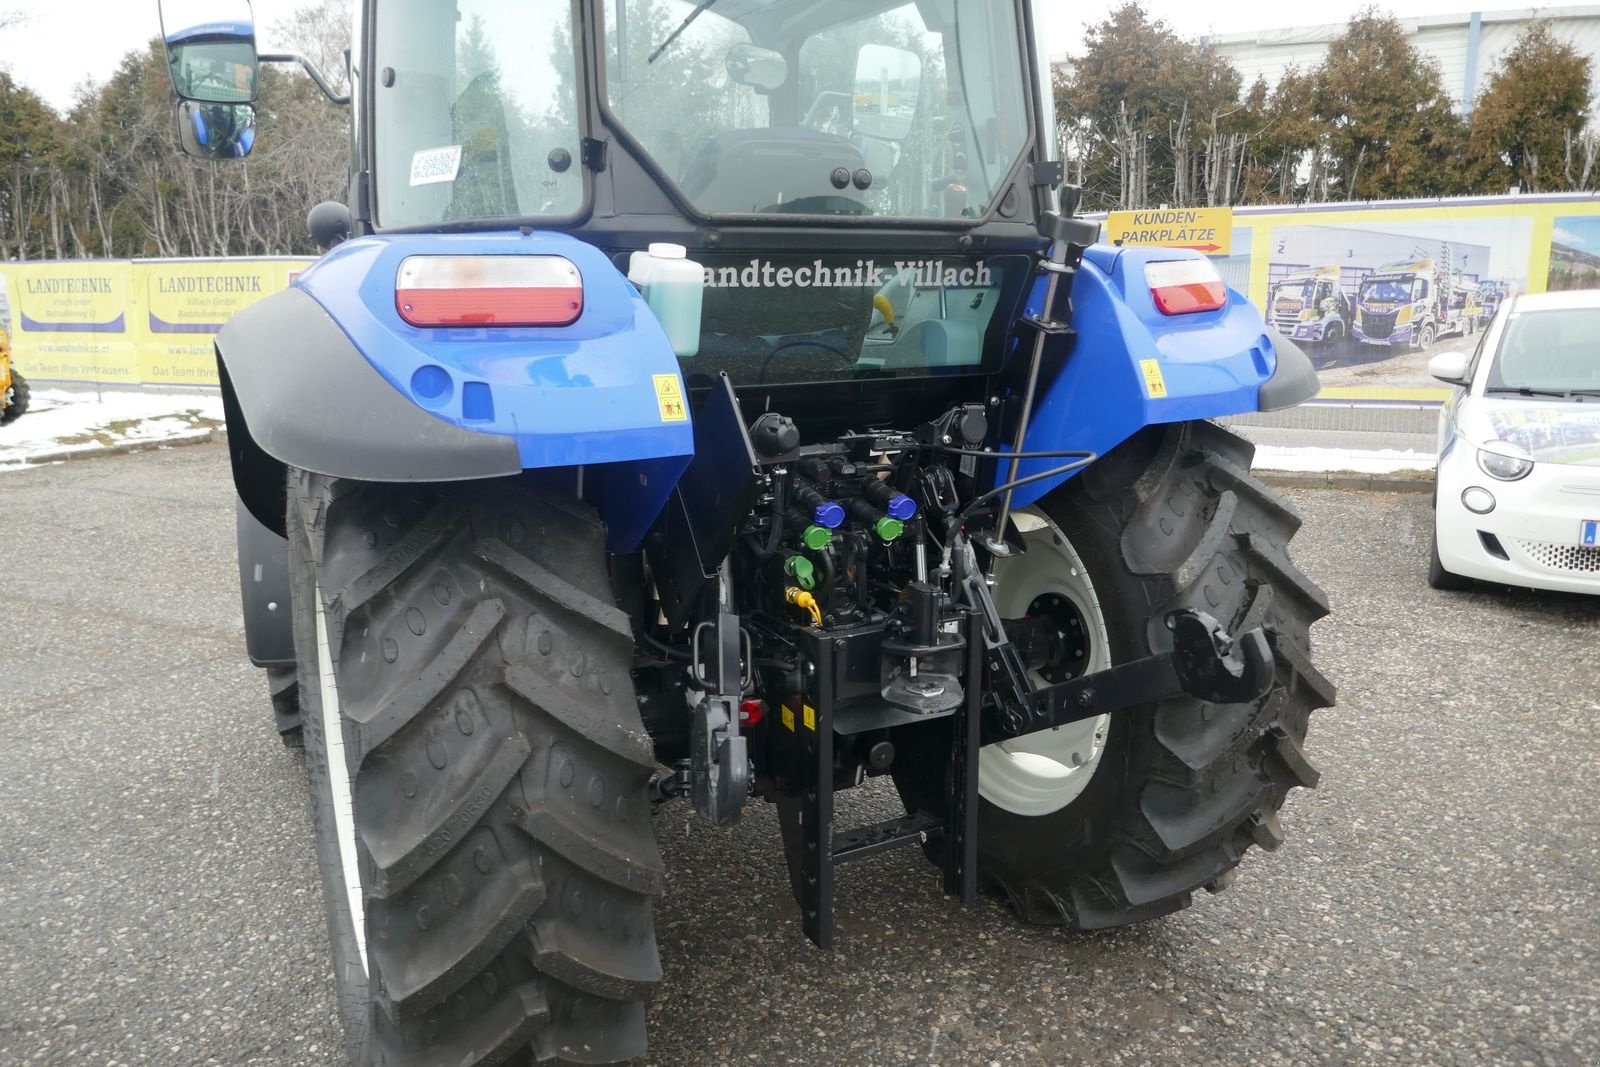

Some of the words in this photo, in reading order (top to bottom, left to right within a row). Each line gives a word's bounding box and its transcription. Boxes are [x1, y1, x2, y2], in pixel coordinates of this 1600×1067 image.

[1133, 211, 1204, 226] KUNDEN-
[1121, 225, 1216, 243] PARKPLÄTZE
[702, 259, 992, 288] andtechnik-Villach
[26, 278, 113, 294] LANDTECHNIK
[159, 275, 262, 293] LANDTECHNIK
[187, 298, 212, 306] Villach
[213, 298, 237, 306] GmbH
[153, 366, 169, 377] Das
[172, 366, 195, 377] Team
